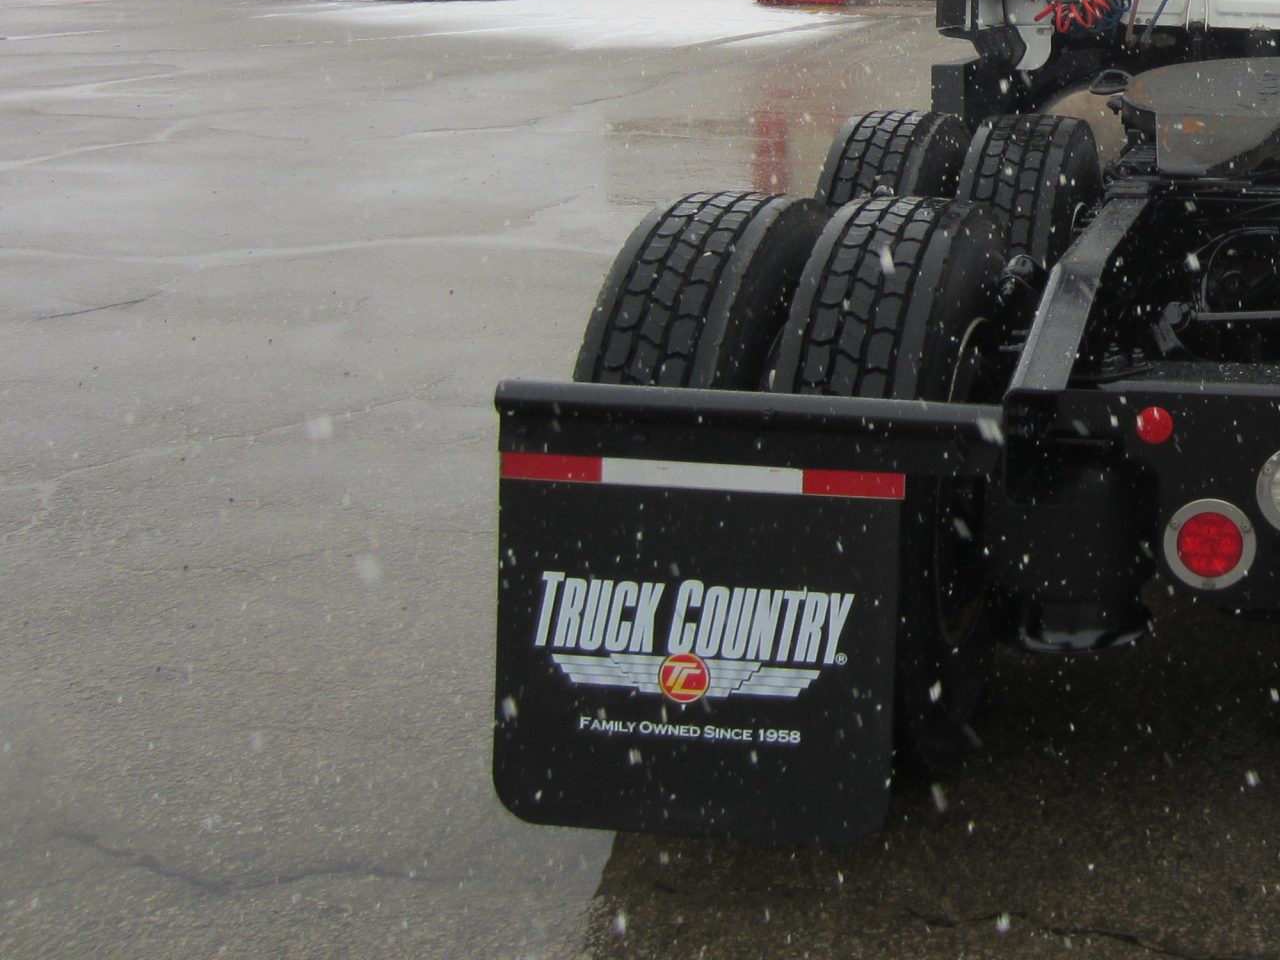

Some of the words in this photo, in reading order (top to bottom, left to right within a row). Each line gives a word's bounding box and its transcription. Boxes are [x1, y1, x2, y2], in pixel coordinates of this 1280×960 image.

[534, 571, 665, 653] TRUCK
[579, 716, 637, 733] FAMILY
[639, 721, 701, 737] OWNED
[703, 725, 753, 741] SINCE
[758, 728, 801, 743] 1958
